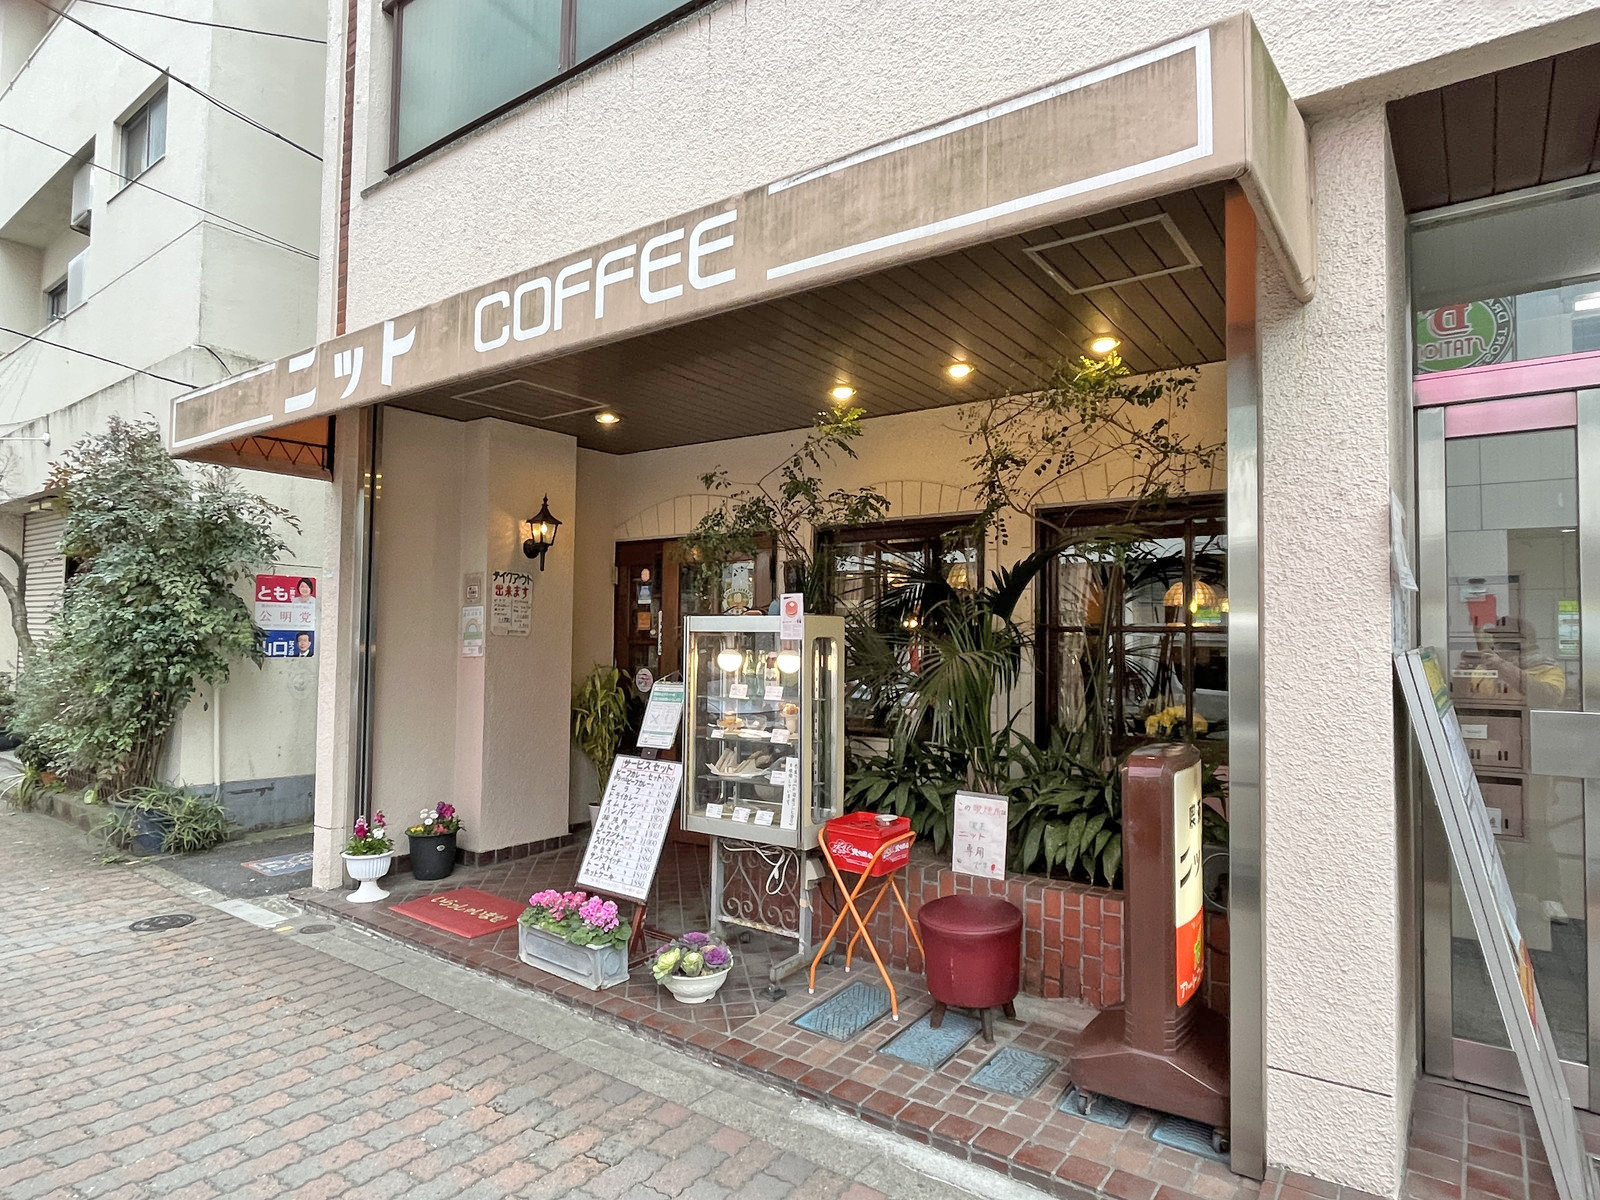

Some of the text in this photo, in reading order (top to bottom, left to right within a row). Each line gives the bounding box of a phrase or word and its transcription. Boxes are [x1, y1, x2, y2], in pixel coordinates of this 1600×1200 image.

[474, 209, 738, 353] COFFEE
[284, 320, 416, 414] ニット
[493, 571, 533, 586] テイクアウト
[257, 585, 288, 602] とも
[495, 584, 529, 600] 出来ます
[260, 610, 312, 623] 公明党
